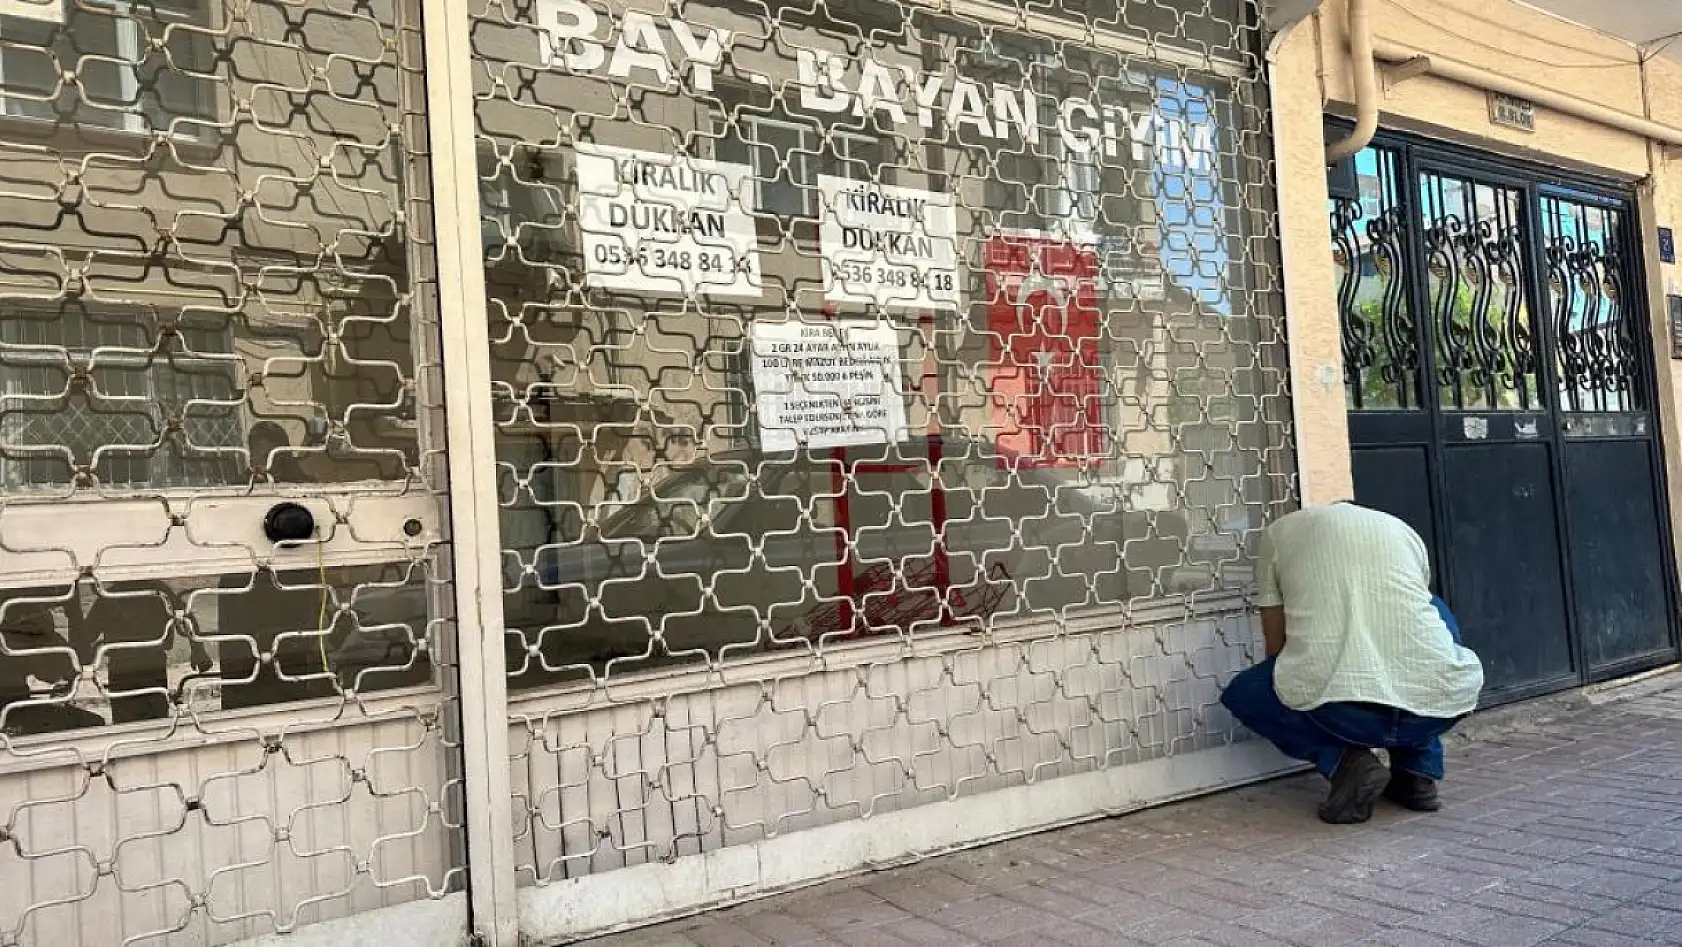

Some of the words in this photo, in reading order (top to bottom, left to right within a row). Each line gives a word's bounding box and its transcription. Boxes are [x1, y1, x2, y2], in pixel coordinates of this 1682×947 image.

[535, 0, 731, 91] BAY
[797, 50, 1040, 146] BAYAN
[654, 249, 692, 270] 348
[699, 252, 723, 273] 84
[877, 267, 907, 288] 348
[935, 274, 953, 291] 18
